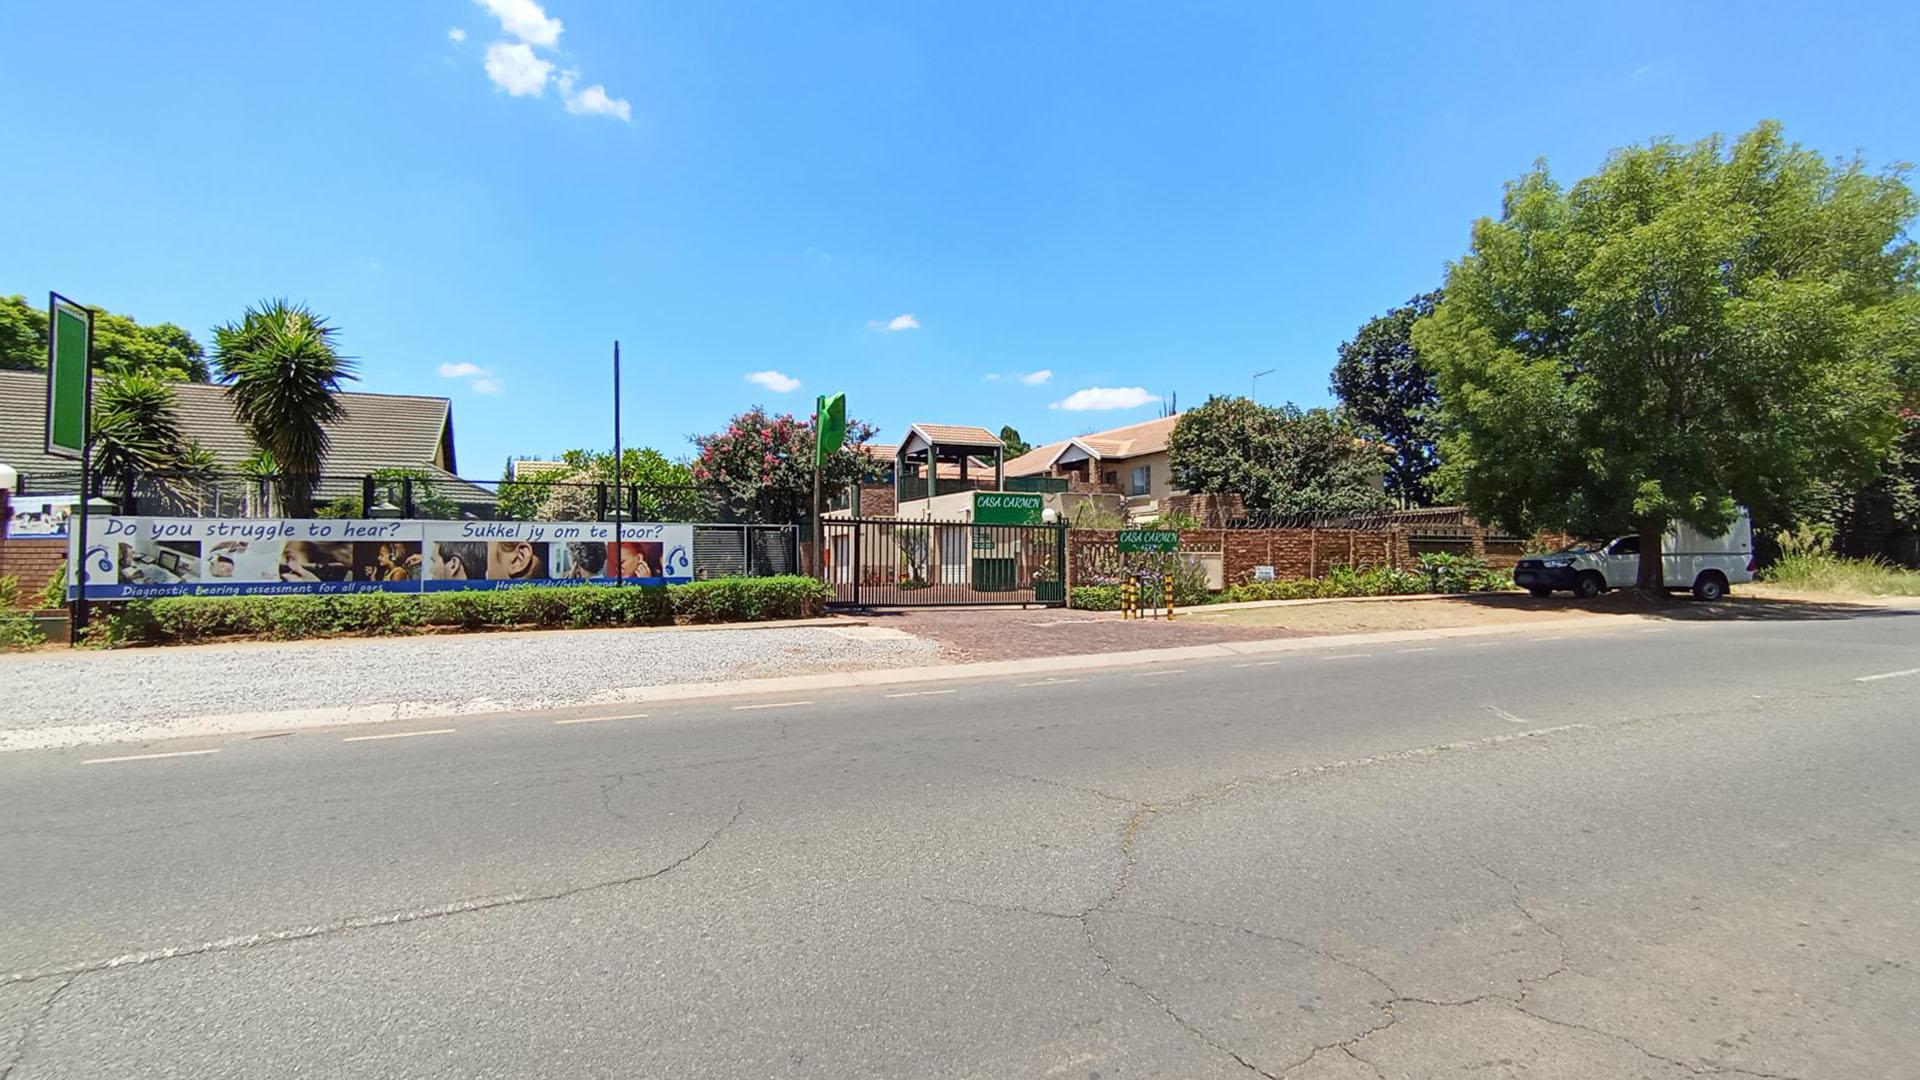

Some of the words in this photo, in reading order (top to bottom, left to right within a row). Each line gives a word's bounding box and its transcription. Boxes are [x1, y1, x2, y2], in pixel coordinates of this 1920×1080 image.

[977, 496, 1001, 508] CASA
[1003, 496, 1040, 509] CARMEN
[104, 519, 137, 536] Do
[151, 524, 192, 540] you
[206, 521, 296, 541] struggle
[308, 523, 332, 537] to
[344, 521, 401, 537] hear?
[462, 522, 522, 538] Sukkel
[527, 525, 545, 541] jy
[554, 526, 580, 538] om
[590, 525, 608, 538] te
[1120, 532, 1142, 543] CASA
[1143, 532, 1178, 543] CARMEN
[120, 585, 189, 598] Diagnostic
[245, 584, 313, 594] assessment
[318, 582, 336, 593] for
[341, 582, 356, 592] all
